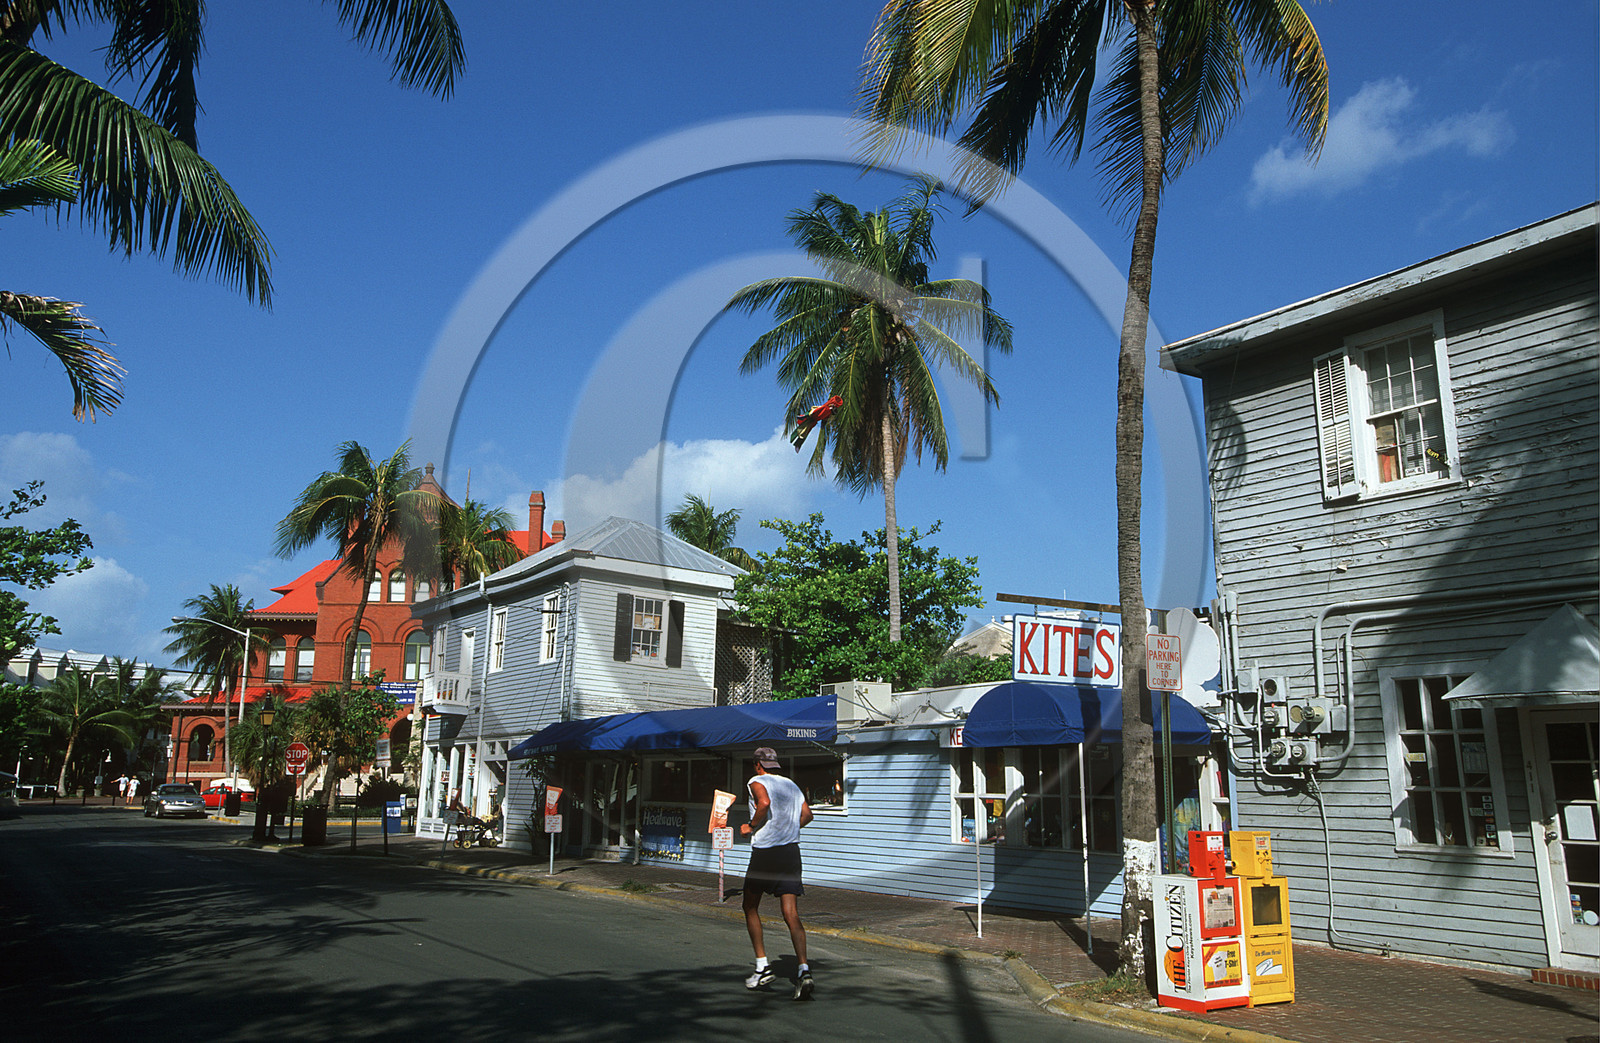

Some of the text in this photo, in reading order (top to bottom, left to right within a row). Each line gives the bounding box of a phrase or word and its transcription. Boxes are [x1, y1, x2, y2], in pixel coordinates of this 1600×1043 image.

[1157, 639, 1170, 650] NO
[1017, 621, 1115, 680] KITES
[1148, 649, 1180, 663] PARKING
[1156, 662, 1172, 671] HERE
[1160, 670, 1169, 678] TO
[1152, 677, 1178, 687] CORNER
[786, 728, 817, 738] BIKINIS
[949, 728, 964, 746] KE
[286, 749, 308, 759] STOP
[642, 808, 683, 827] Heatwave
[1165, 884, 1186, 993] THE CITIZEN
[1227, 950, 1236, 958] Free
[1225, 959, 1239, 968] T-Shirt
